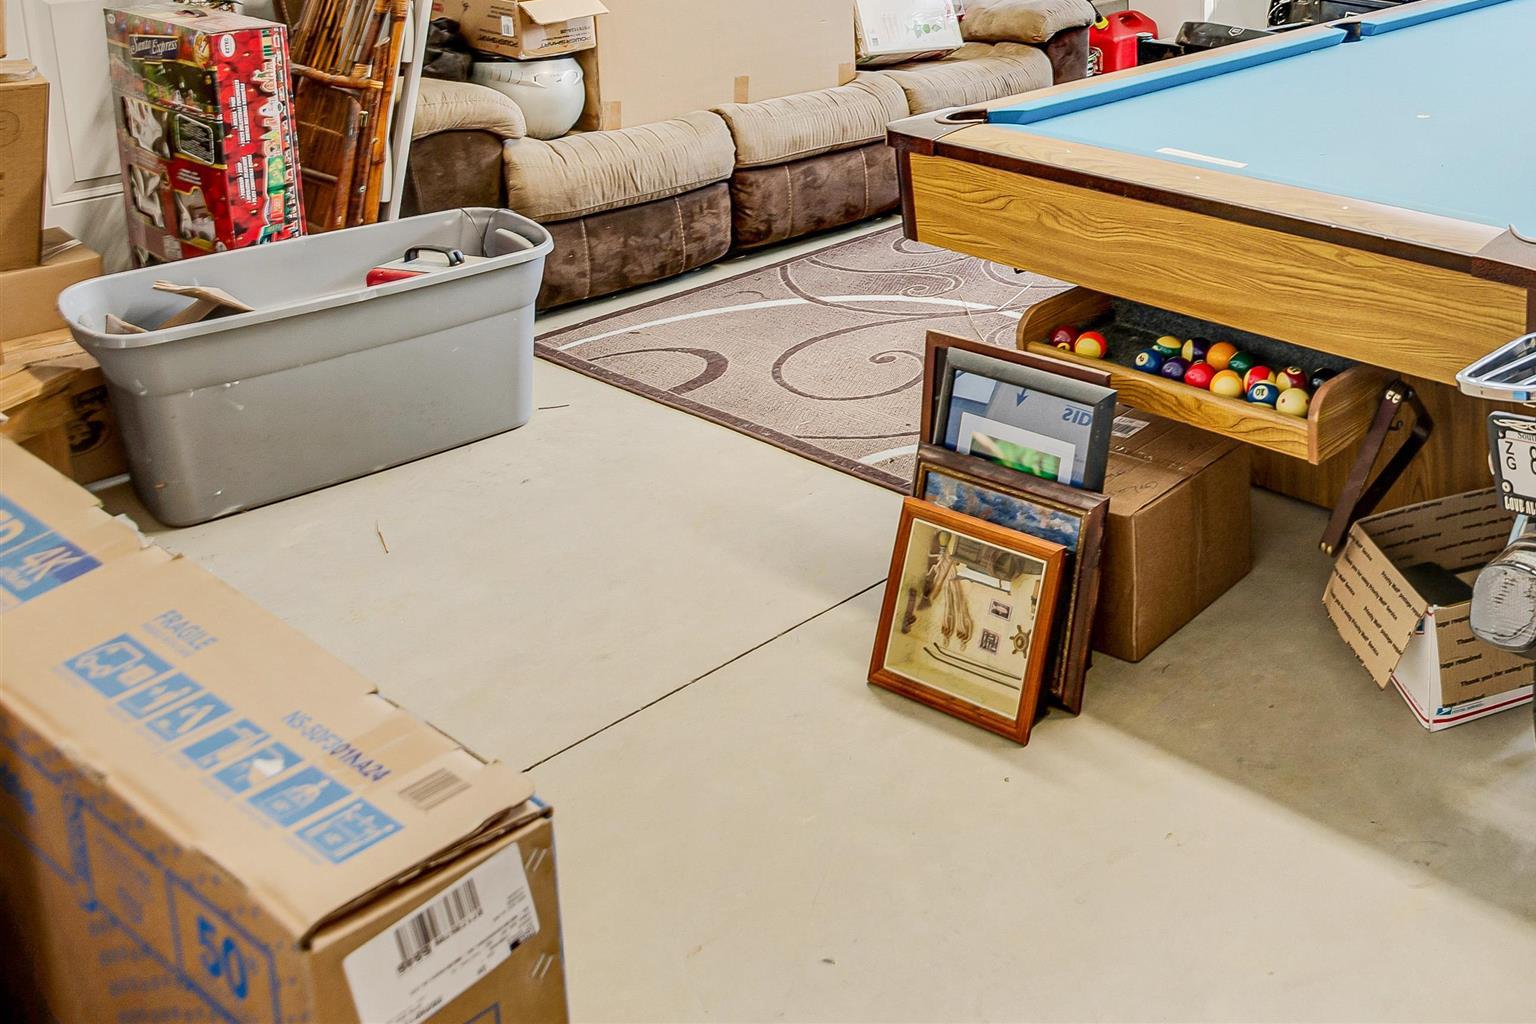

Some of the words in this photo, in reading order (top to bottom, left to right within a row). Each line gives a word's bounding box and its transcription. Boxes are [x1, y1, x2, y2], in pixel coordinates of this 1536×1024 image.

[151, 37, 178, 56] Express
[1504, 496, 1525, 512] LOVE
[154, 608, 219, 651] FRAGILE
[196, 915, 248, 1001] 50
